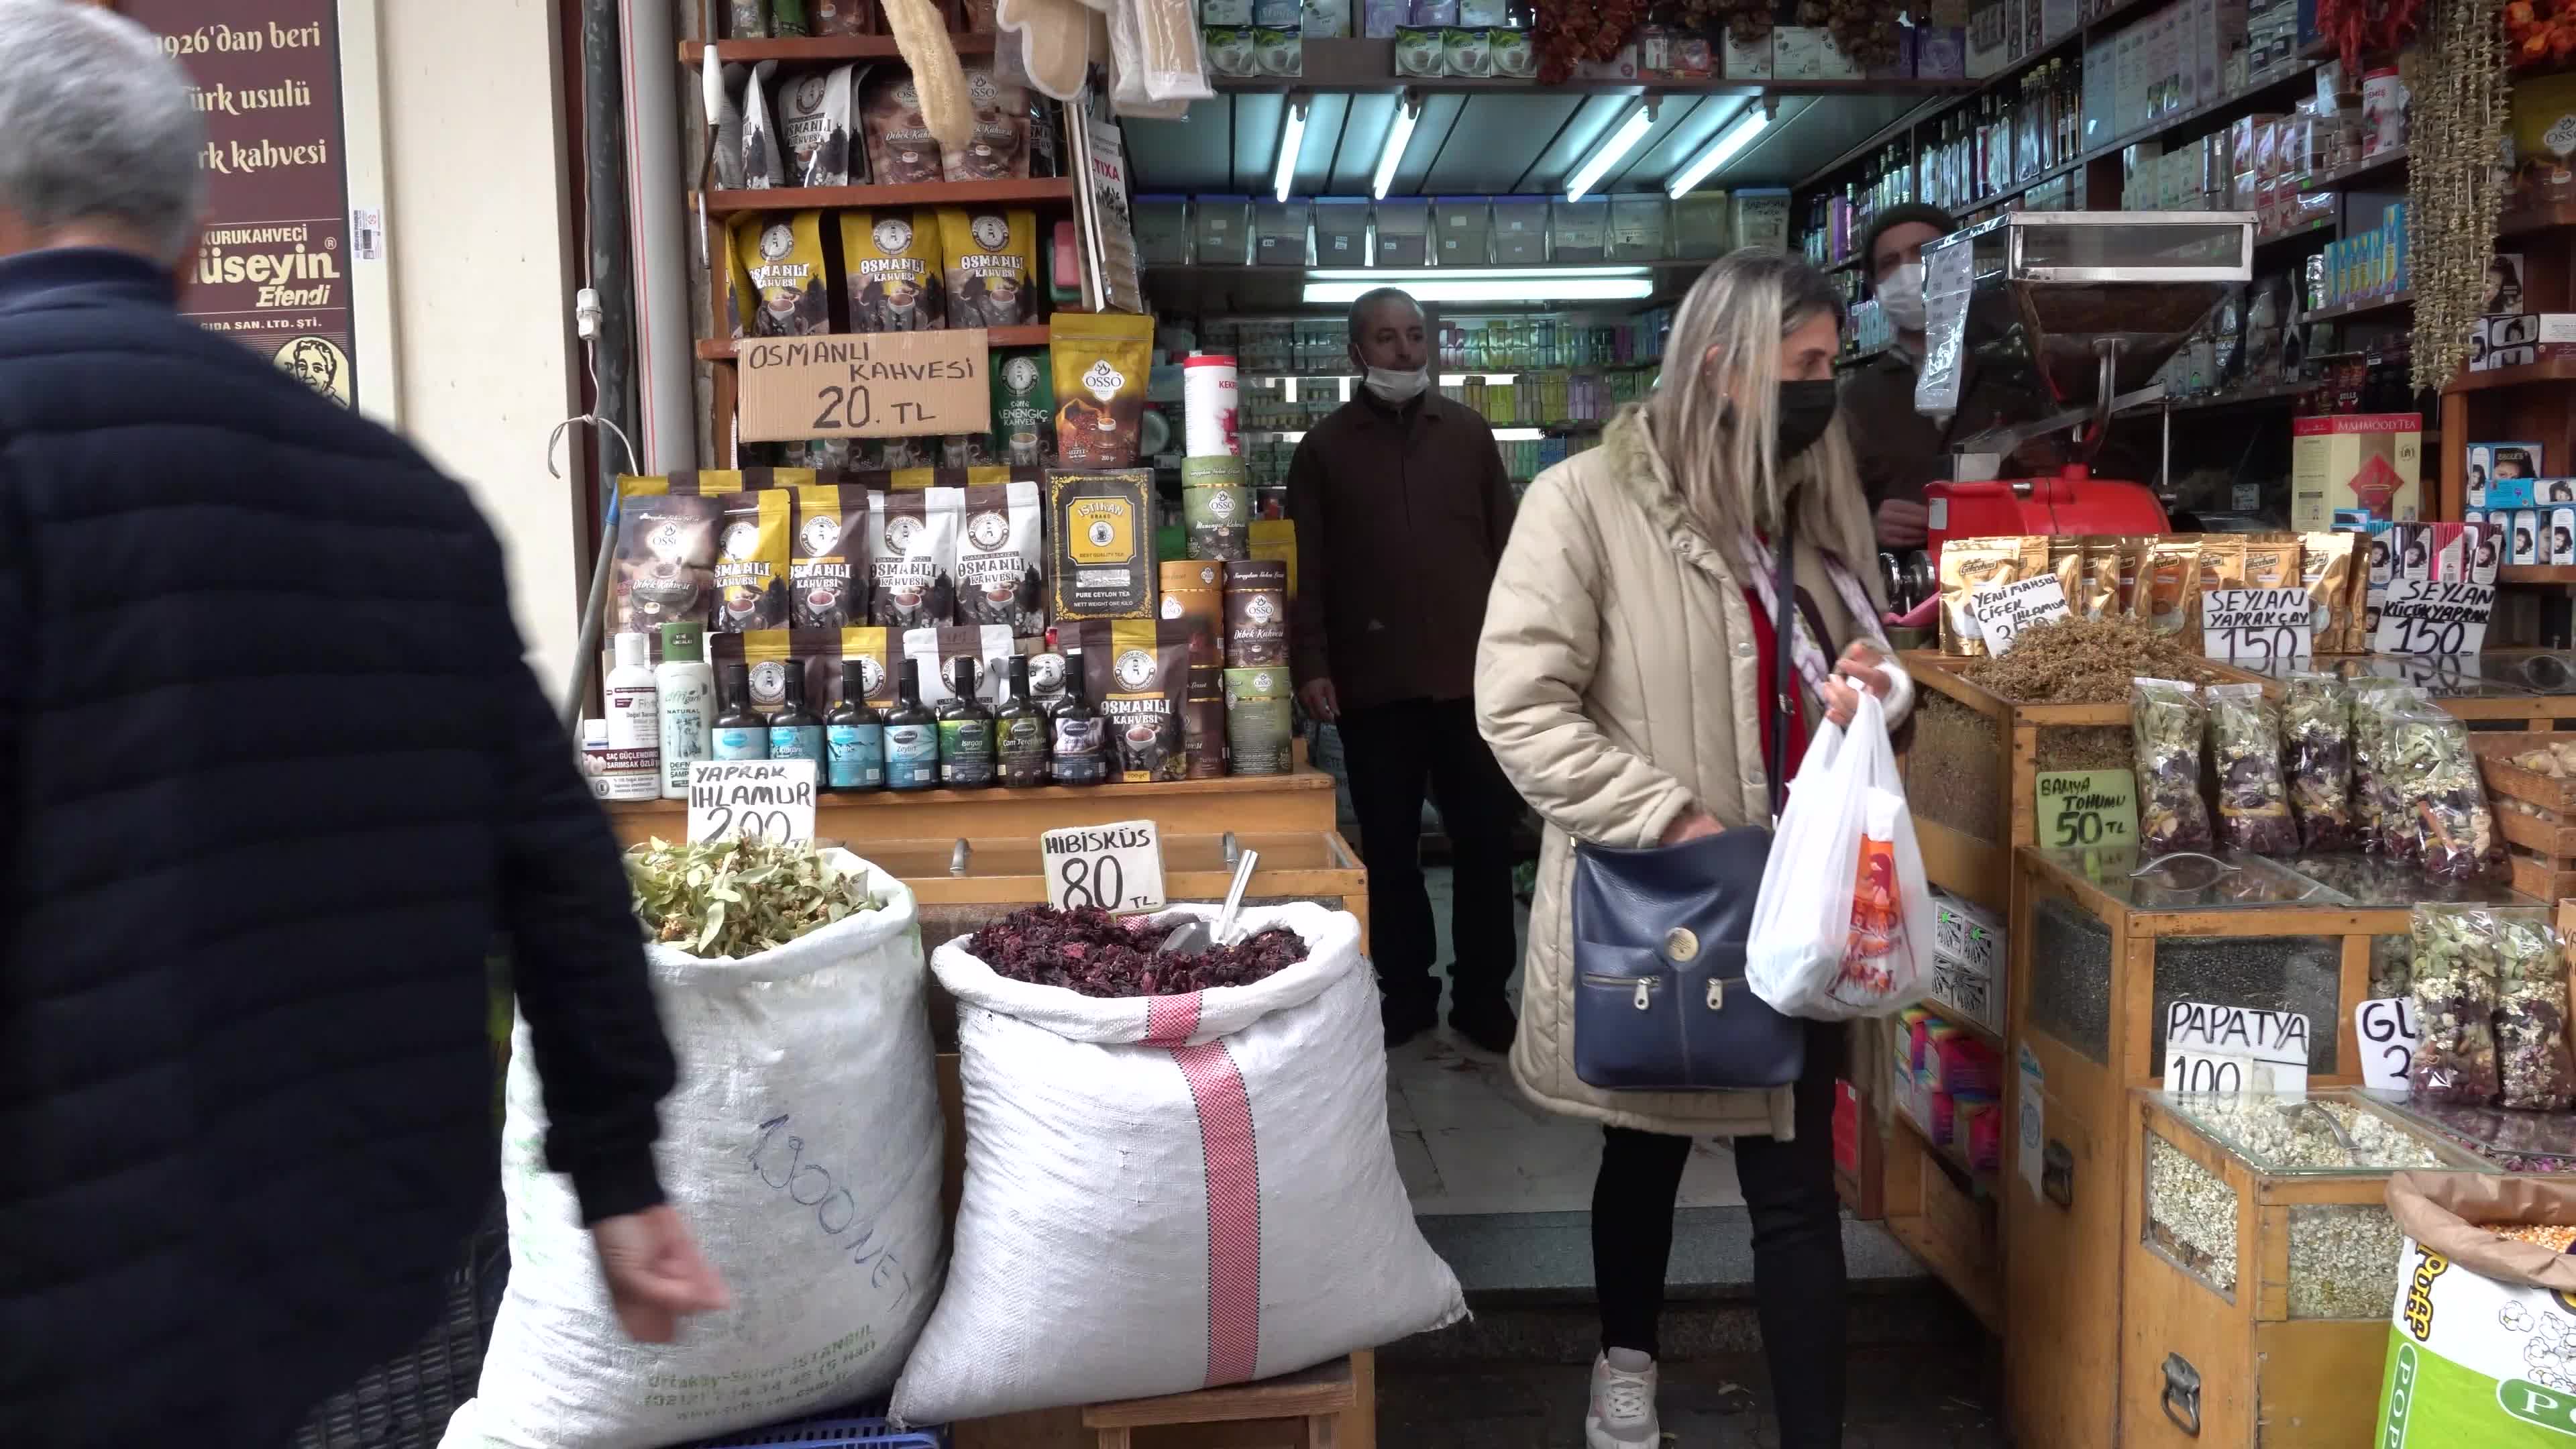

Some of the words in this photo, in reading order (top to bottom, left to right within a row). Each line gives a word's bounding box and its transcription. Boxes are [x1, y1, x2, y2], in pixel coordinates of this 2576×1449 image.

[268, 21, 321, 48] beri
[182, 83, 241, 115] ürk
[239, 79, 312, 109] usulü
[896, 91, 918, 99] OSS
[2546, 130, 2576, 144] OSS
[230, 139, 327, 173] kahvesi
[1093, 158, 1120, 182] TIXA
[203, 224, 308, 246] KURUKAHVECİ
[860, 258, 926, 275] OSMANLI
[961, 254, 1024, 270] OSMANLI
[256, 284, 331, 307] Efendi
[235, 321, 264, 329] SAN.
[267, 319, 294, 328] LTD.
[749, 341, 869, 370] OSMANLI
[849, 357, 975, 382] KAHVESİ
[1085, 375, 1122, 387] OSSO
[890, 400, 938, 425] TL
[2337, 420, 2397, 431] MAHMOOD
[2398, 419, 2416, 429] TEA
[1211, 501, 1234, 509] OSSO
[714, 562, 771, 578] SMANLI
[958, 557, 1026, 578] OSMANLI
[1972, 586, 2008, 608] YENİ
[2206, 590, 2305, 613] SEYLAN
[2400, 580, 2495, 605] SEYLAN
[1248, 606, 1273, 614] OSSO
[1978, 599, 2026, 623] ÇİÇEK
[2210, 612, 2278, 627] YAPRAK
[2278, 610, 2310, 627] ÇAY
[1100, 699, 1171, 715] OSMANLI
[606, 753, 619, 761] SAÇ
[606, 760, 639, 769] SARIMSAK
[695, 765, 788, 784] YAPRAK
[690, 782, 812, 808] IHLAMUR
[2055, 811, 2103, 847] 50
[2104, 820, 2127, 834] TL
[1061, 855, 1124, 911] 80
[2168, 1001, 2308, 1053] PAPATYA
[2173, 1055, 2241, 1096] 100
